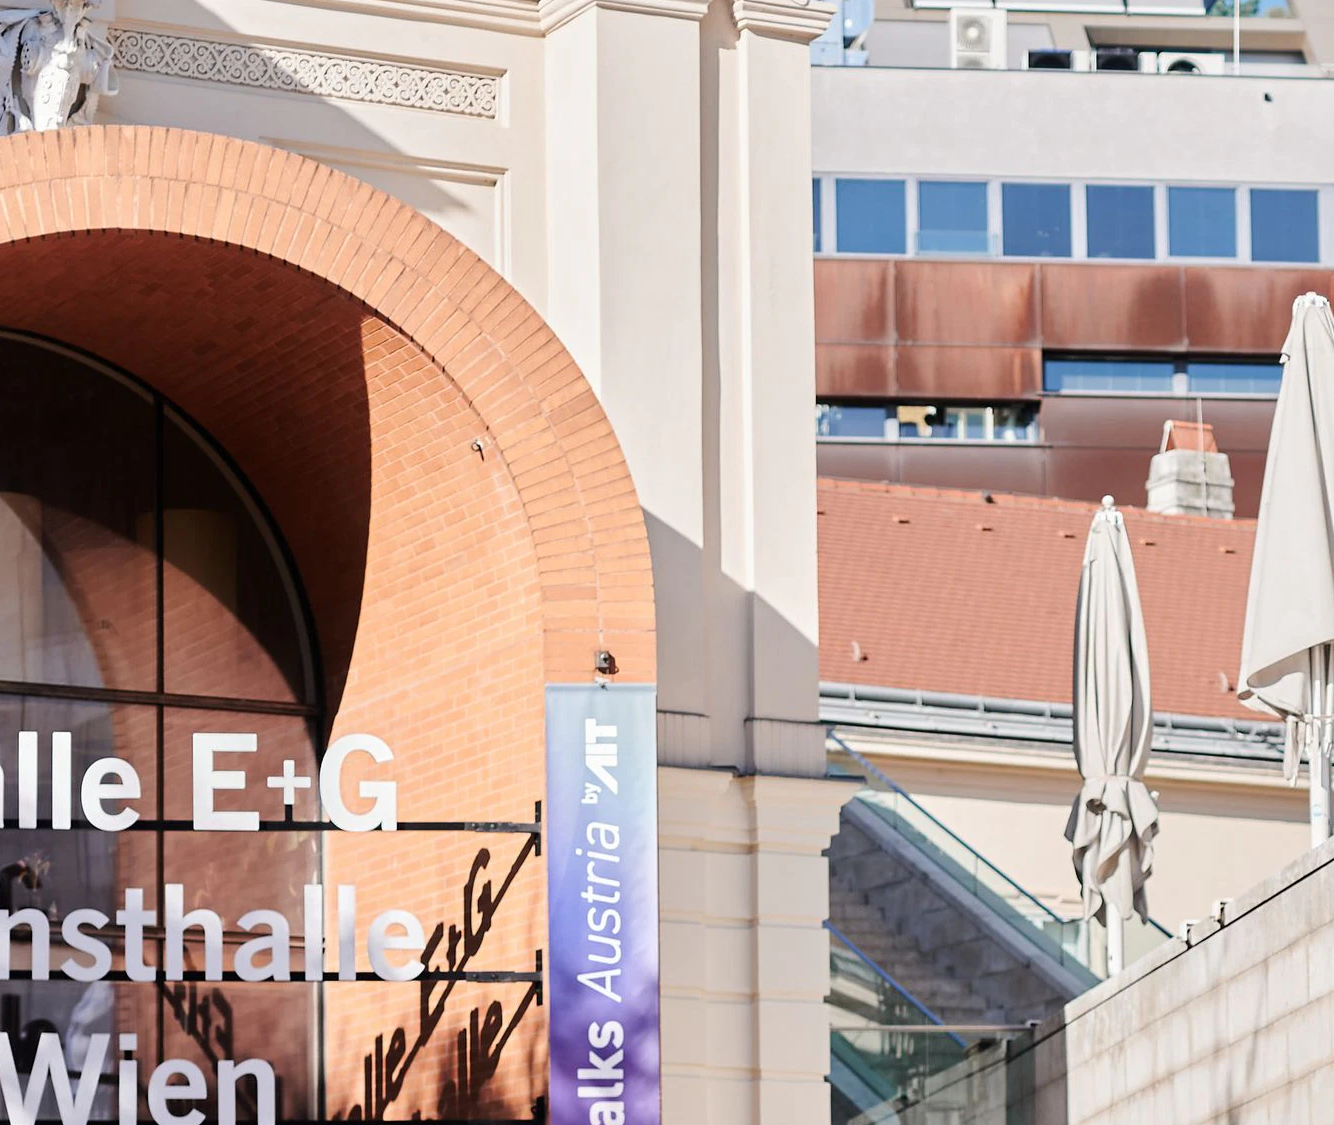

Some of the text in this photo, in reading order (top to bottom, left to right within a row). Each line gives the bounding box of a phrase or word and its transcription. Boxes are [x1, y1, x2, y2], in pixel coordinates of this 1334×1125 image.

[192, 733, 397, 831] E+G
[581, 782, 602, 804] by
[585, 718, 618, 795] AIT
[575, 820, 622, 1004] Austria
